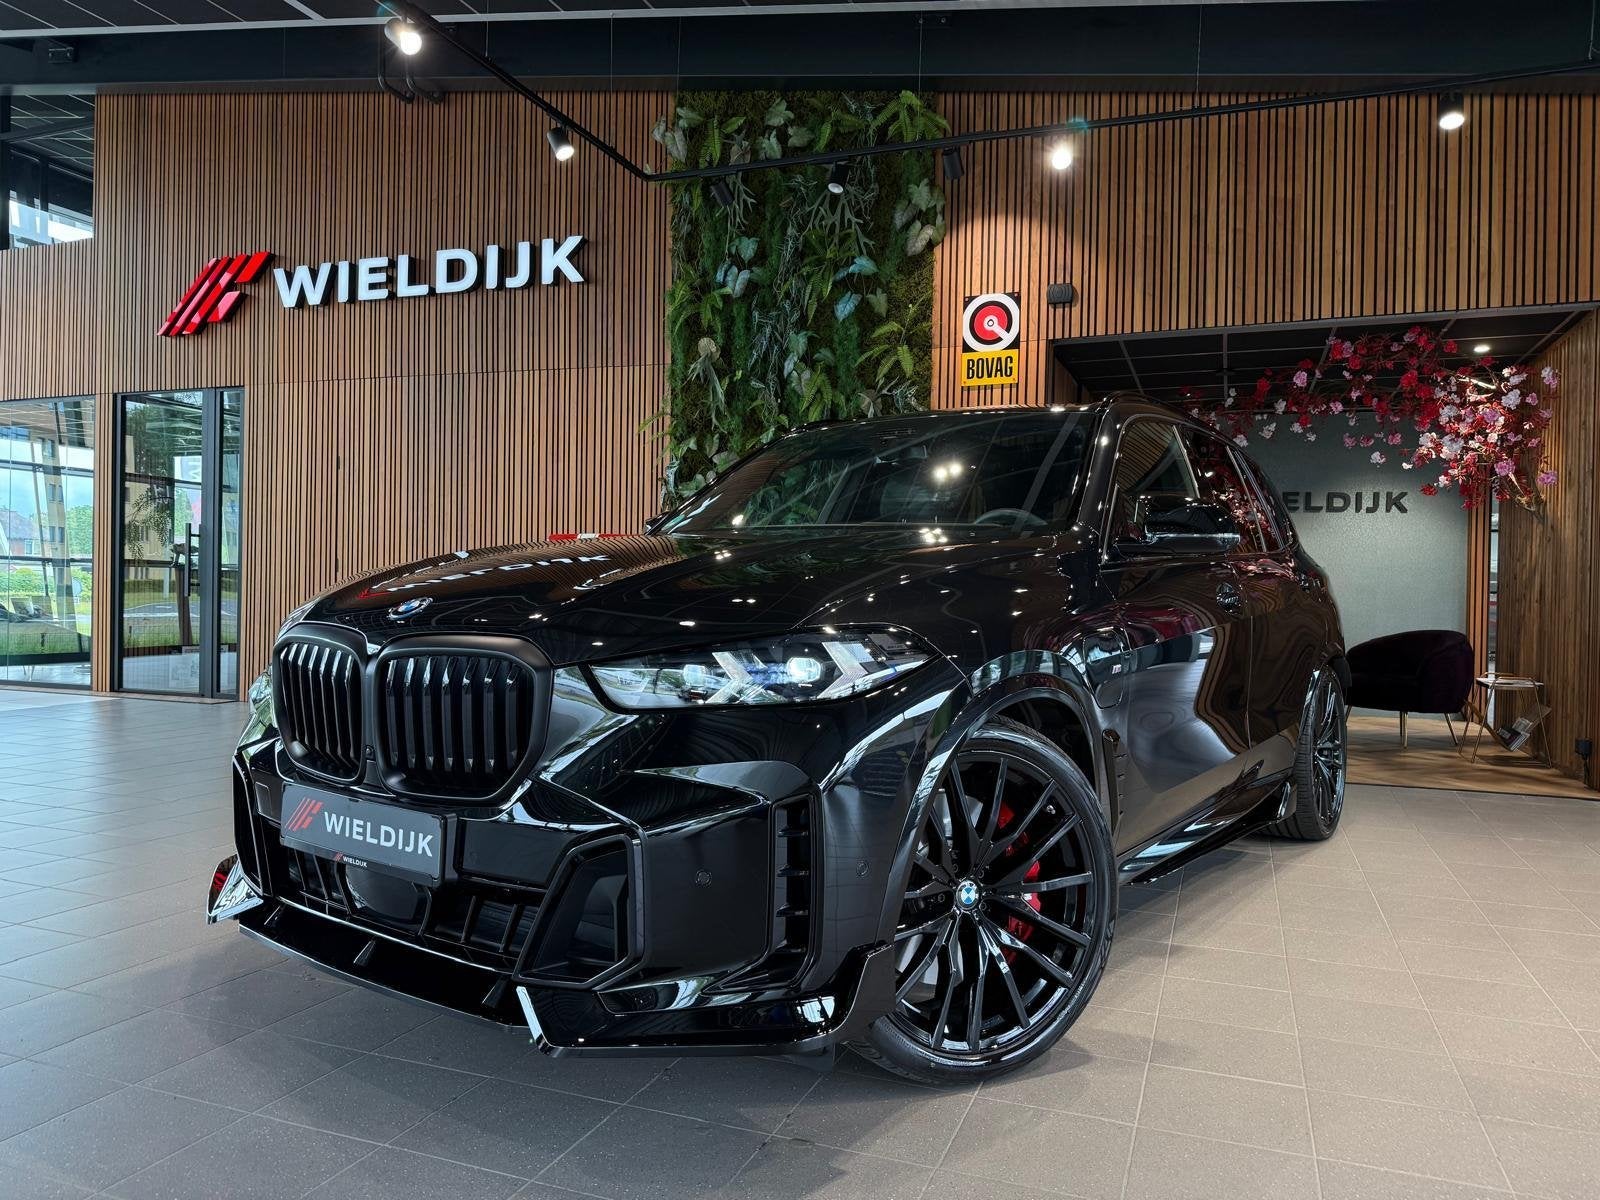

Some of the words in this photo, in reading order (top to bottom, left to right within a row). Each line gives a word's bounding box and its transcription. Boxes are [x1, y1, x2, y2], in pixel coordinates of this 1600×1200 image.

[273, 235, 584, 309] WIELDIJK
[966, 356, 1013, 379] BOVAG
[1282, 491, 1408, 513] ELDIJK
[323, 811, 433, 857] WIELDIJK
